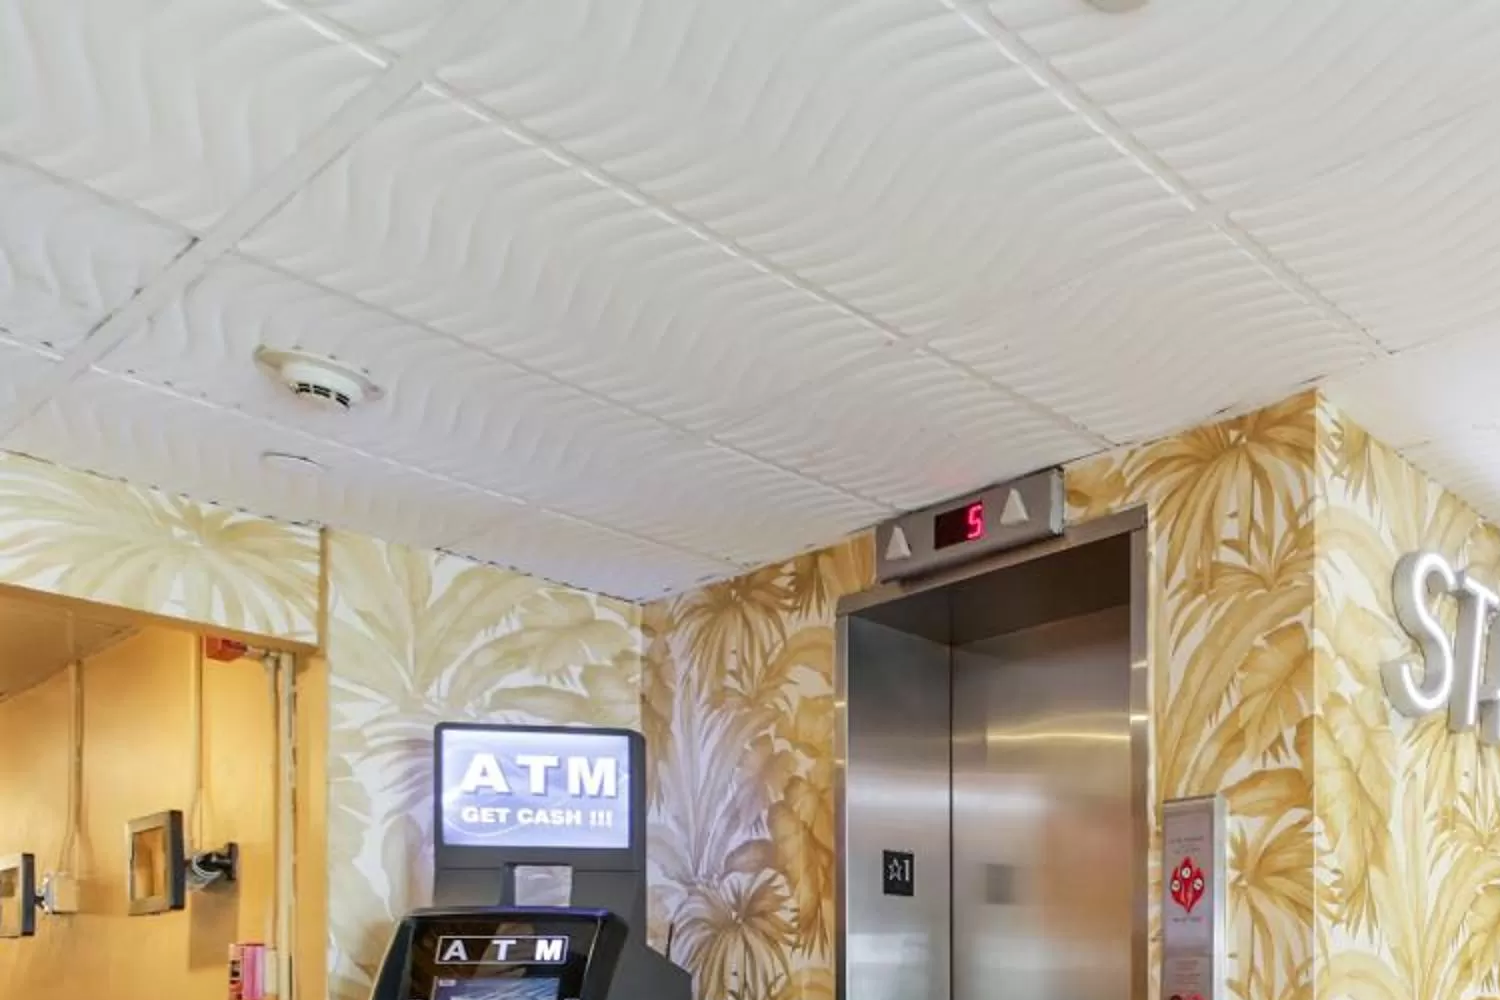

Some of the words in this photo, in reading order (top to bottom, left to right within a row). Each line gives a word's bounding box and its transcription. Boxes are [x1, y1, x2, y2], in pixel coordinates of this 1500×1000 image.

[966, 503, 984, 539] 5
[459, 753, 618, 799] ATM
[461, 806, 511, 824] GET
[517, 807, 582, 826] CASH
[442, 939, 563, 961] ATM
